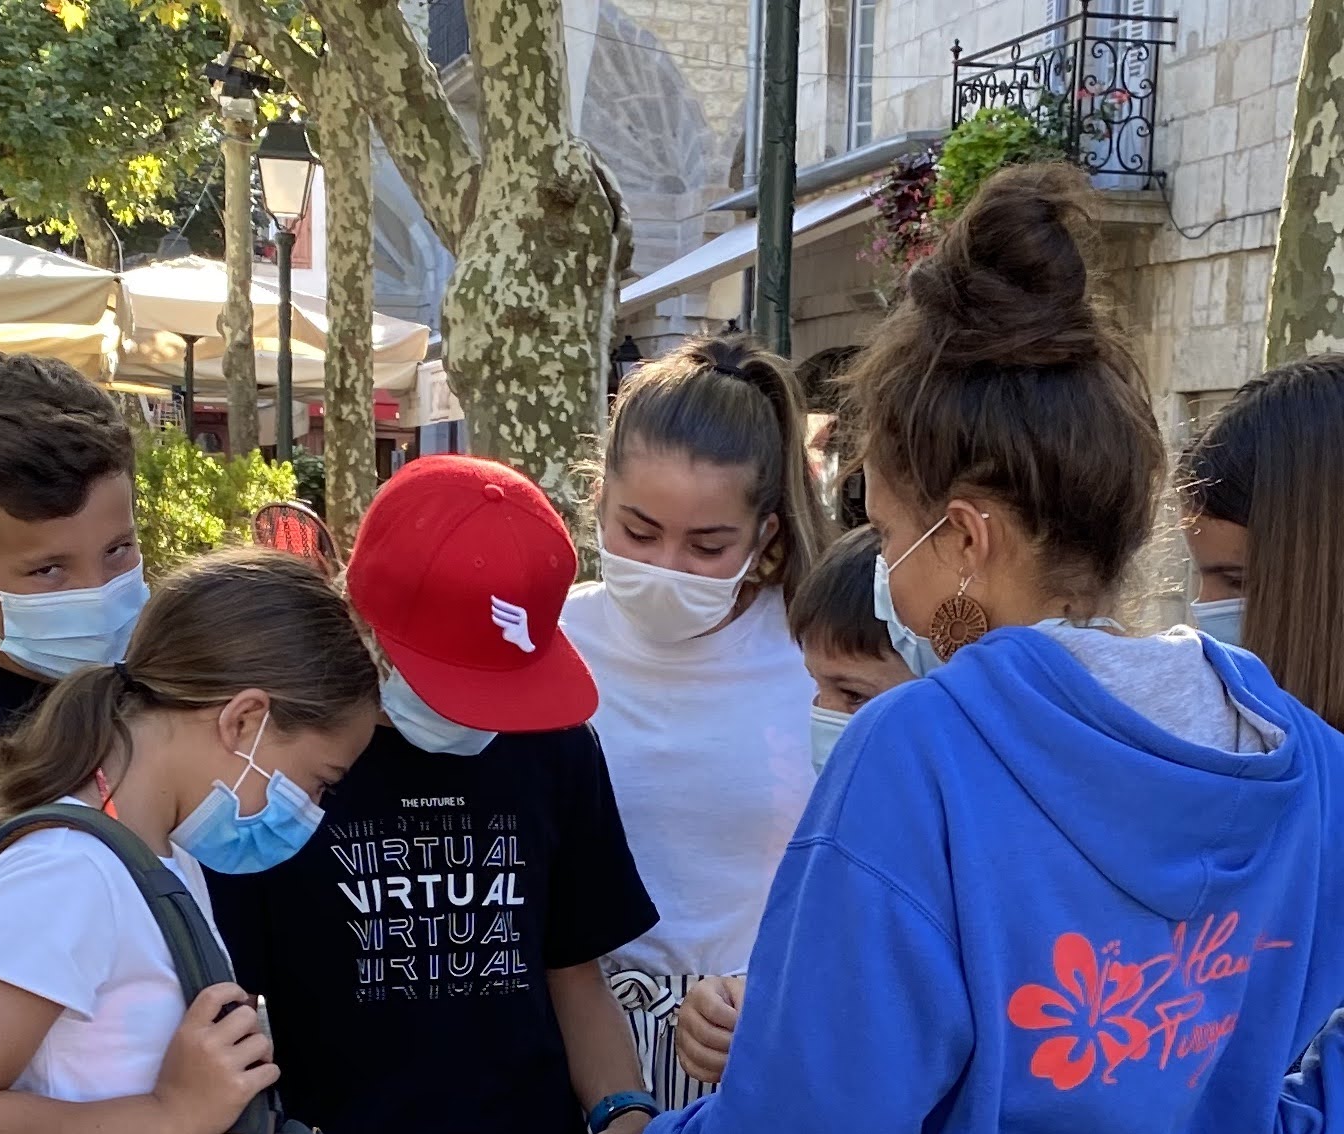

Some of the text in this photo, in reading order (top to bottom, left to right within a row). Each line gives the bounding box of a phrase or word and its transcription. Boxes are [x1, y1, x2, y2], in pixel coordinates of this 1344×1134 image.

[401, 796, 466, 808] THE FUTURE IS
[330, 835, 526, 876] VIRTUAL
[337, 872, 525, 914] VIRTUAL
[346, 910, 521, 950] VIRTUAL
